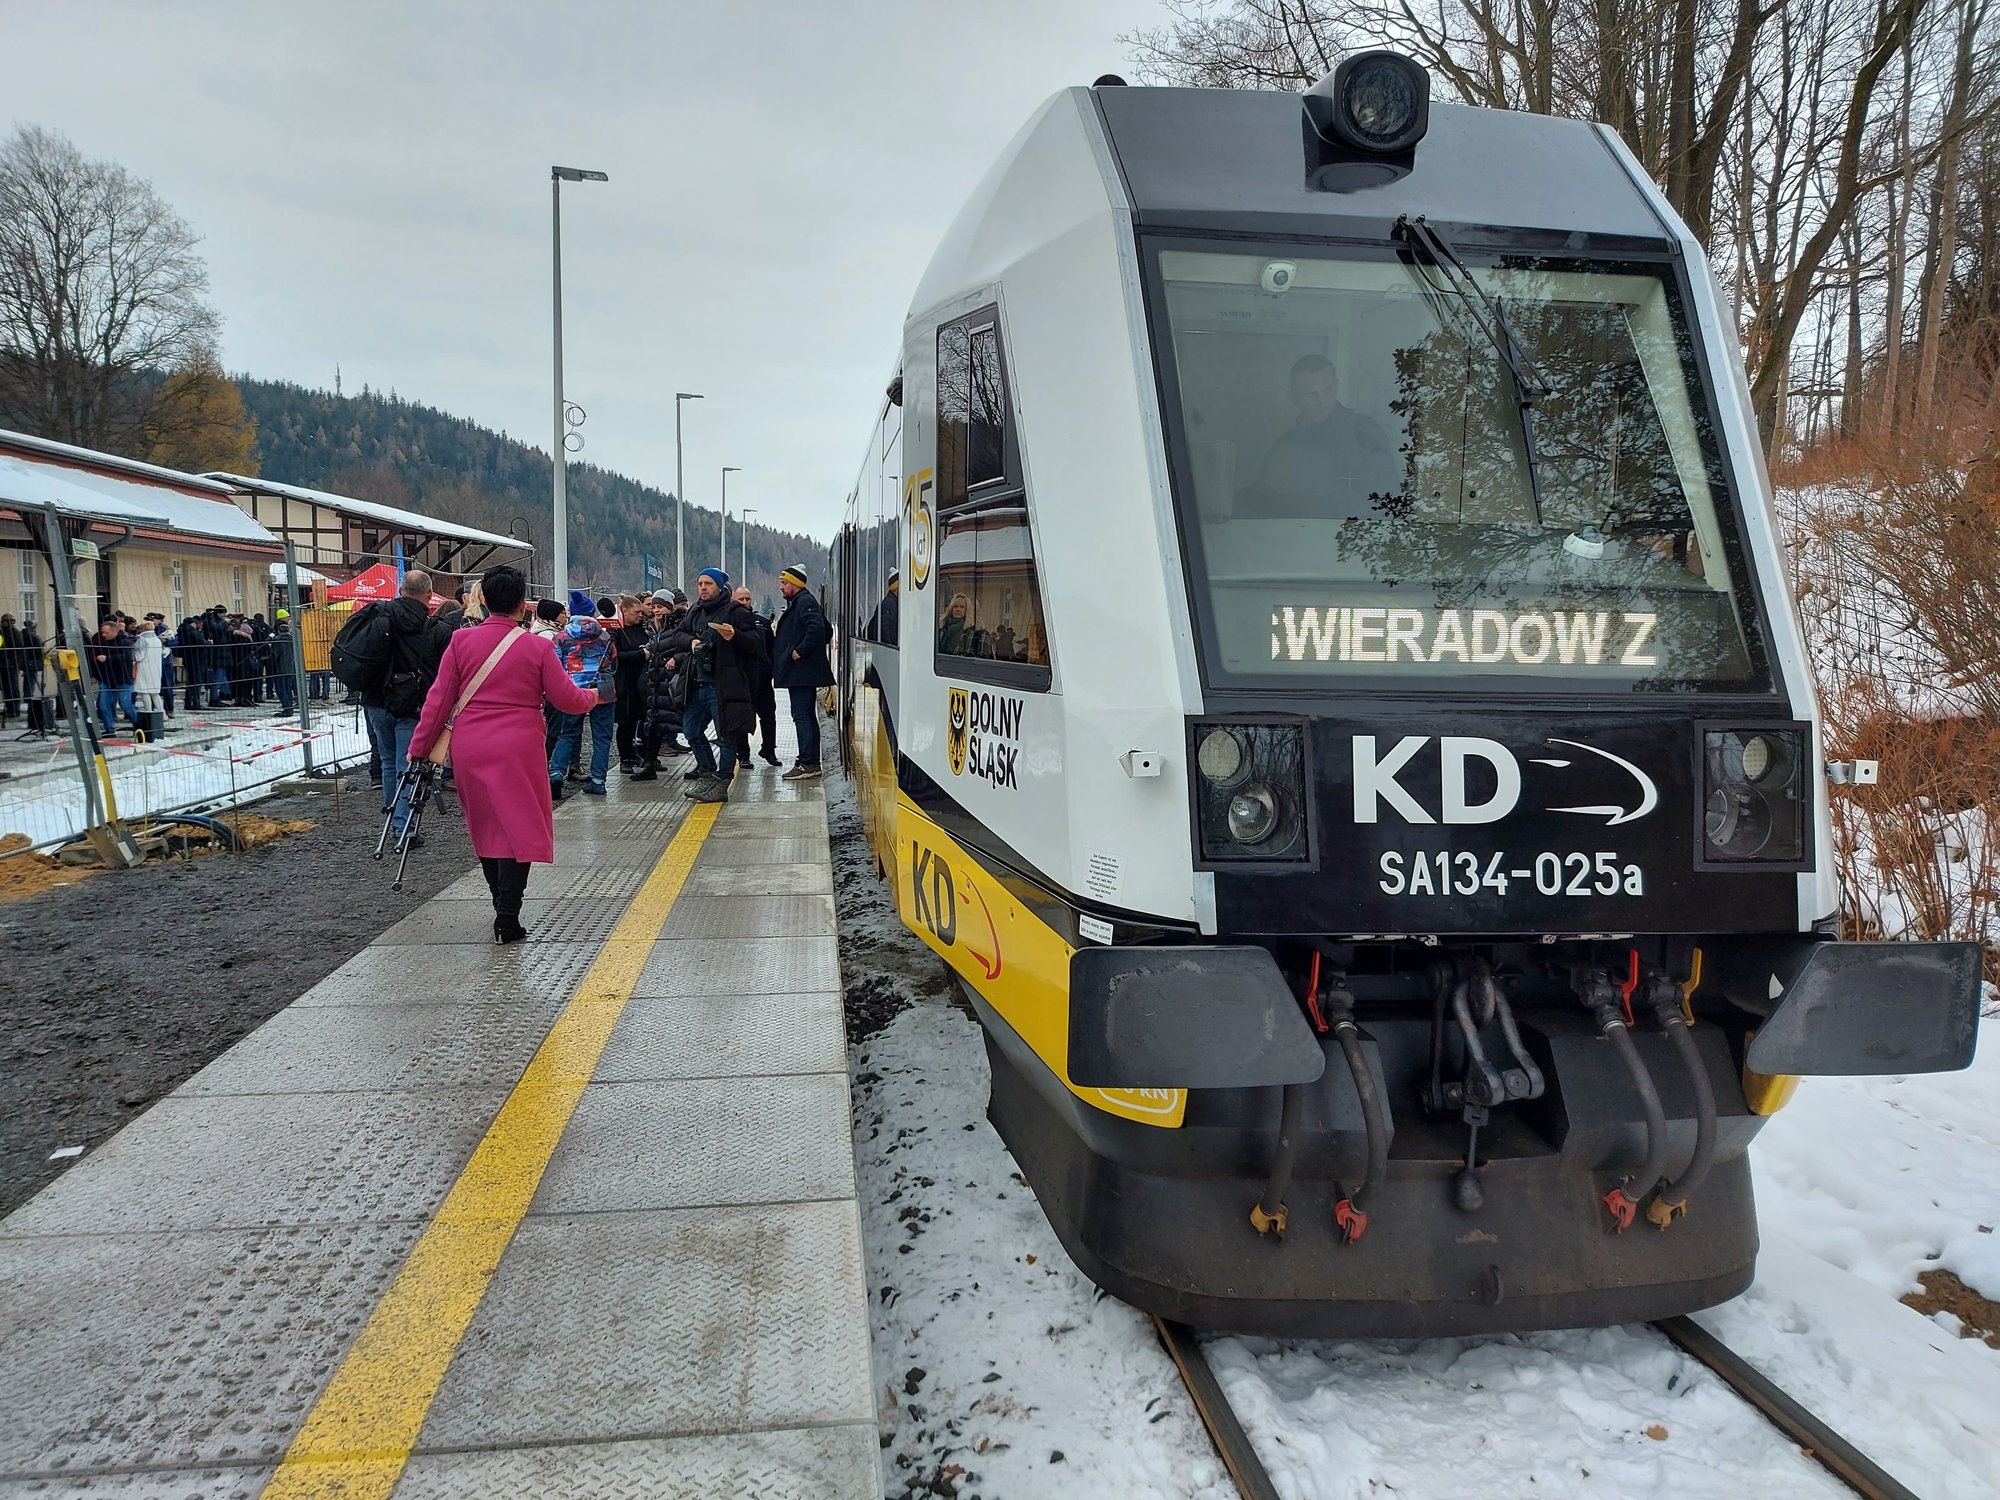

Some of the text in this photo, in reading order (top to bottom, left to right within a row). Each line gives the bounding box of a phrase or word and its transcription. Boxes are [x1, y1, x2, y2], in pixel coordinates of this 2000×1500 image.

[903, 467, 933, 592] 15
[1619, 613, 1657, 666] Z
[970, 691, 1024, 741] DOLNY
[968, 728, 1019, 791] ŚLĄSK
[1352, 735, 1522, 824] KD
[912, 839, 957, 947] KD
[1379, 851, 1643, 896] SA134-025a
